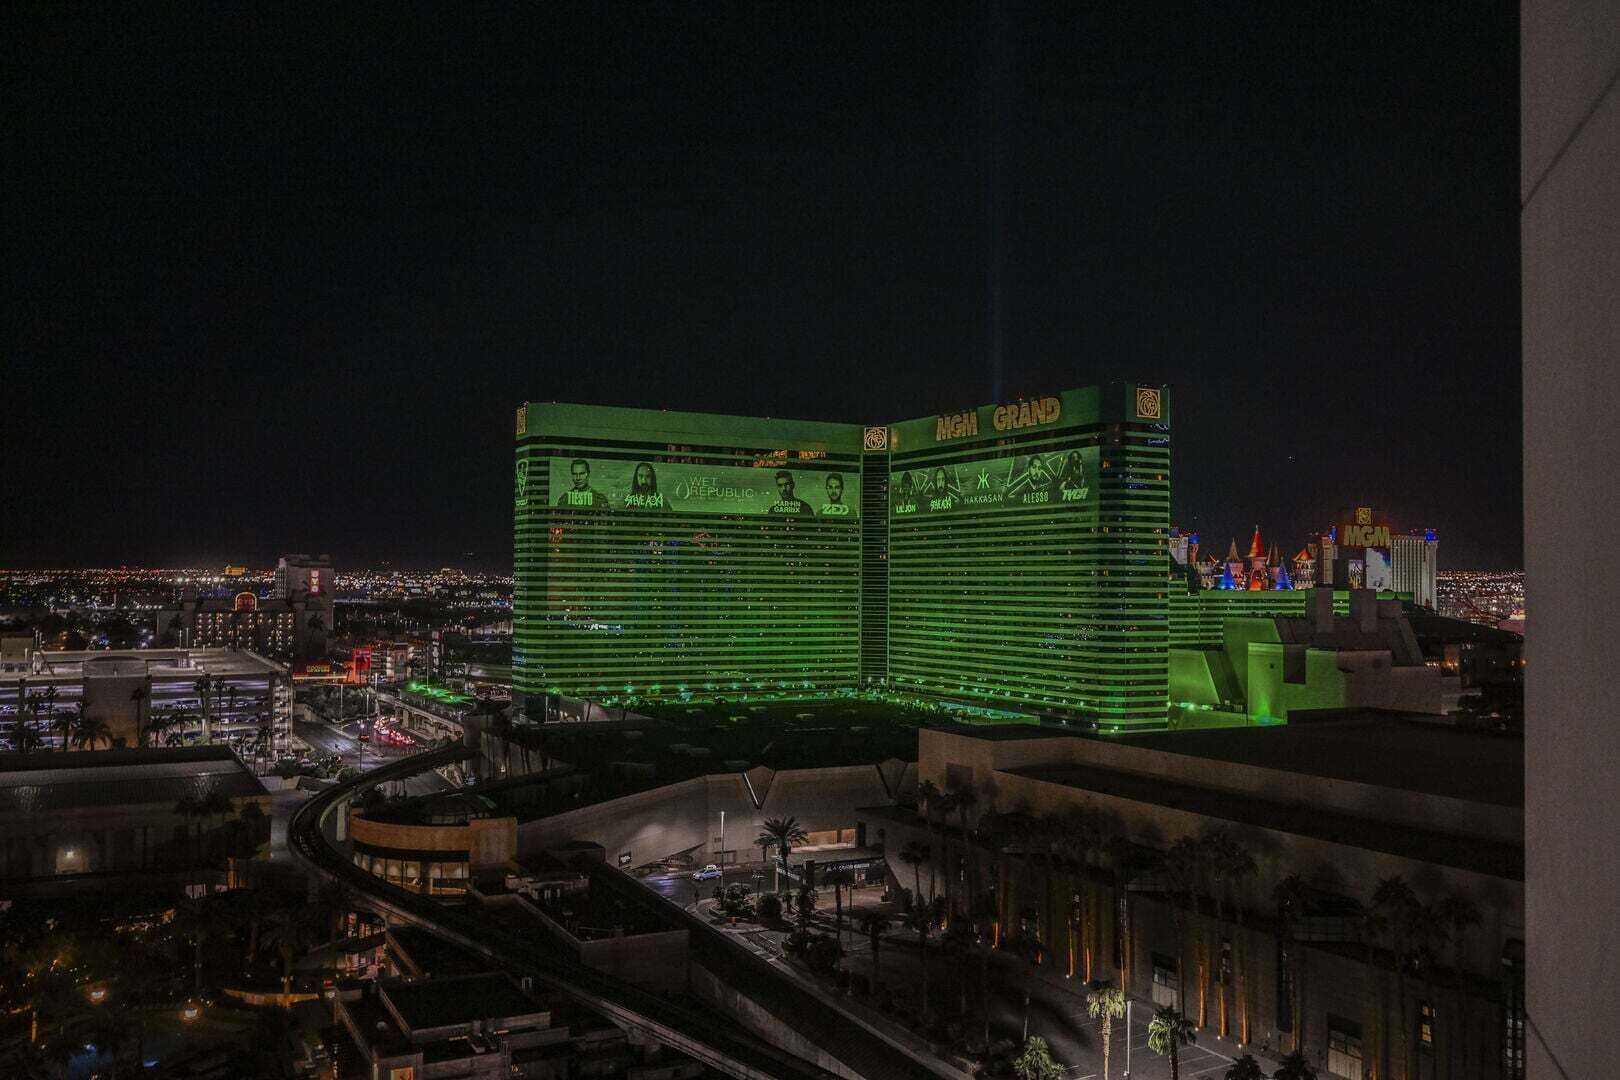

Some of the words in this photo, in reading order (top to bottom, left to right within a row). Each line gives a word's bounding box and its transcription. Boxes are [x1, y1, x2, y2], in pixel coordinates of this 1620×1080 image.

[936, 410, 978, 441] MGM
[993, 397, 1061, 431] GRAND
[690, 476, 720, 487] WET
[690, 487, 755, 498] REPUBLIC
[1022, 491, 1049, 504] ALESSO
[963, 493, 1004, 505] HAKKASAN
[1344, 524, 1390, 549] MGM
